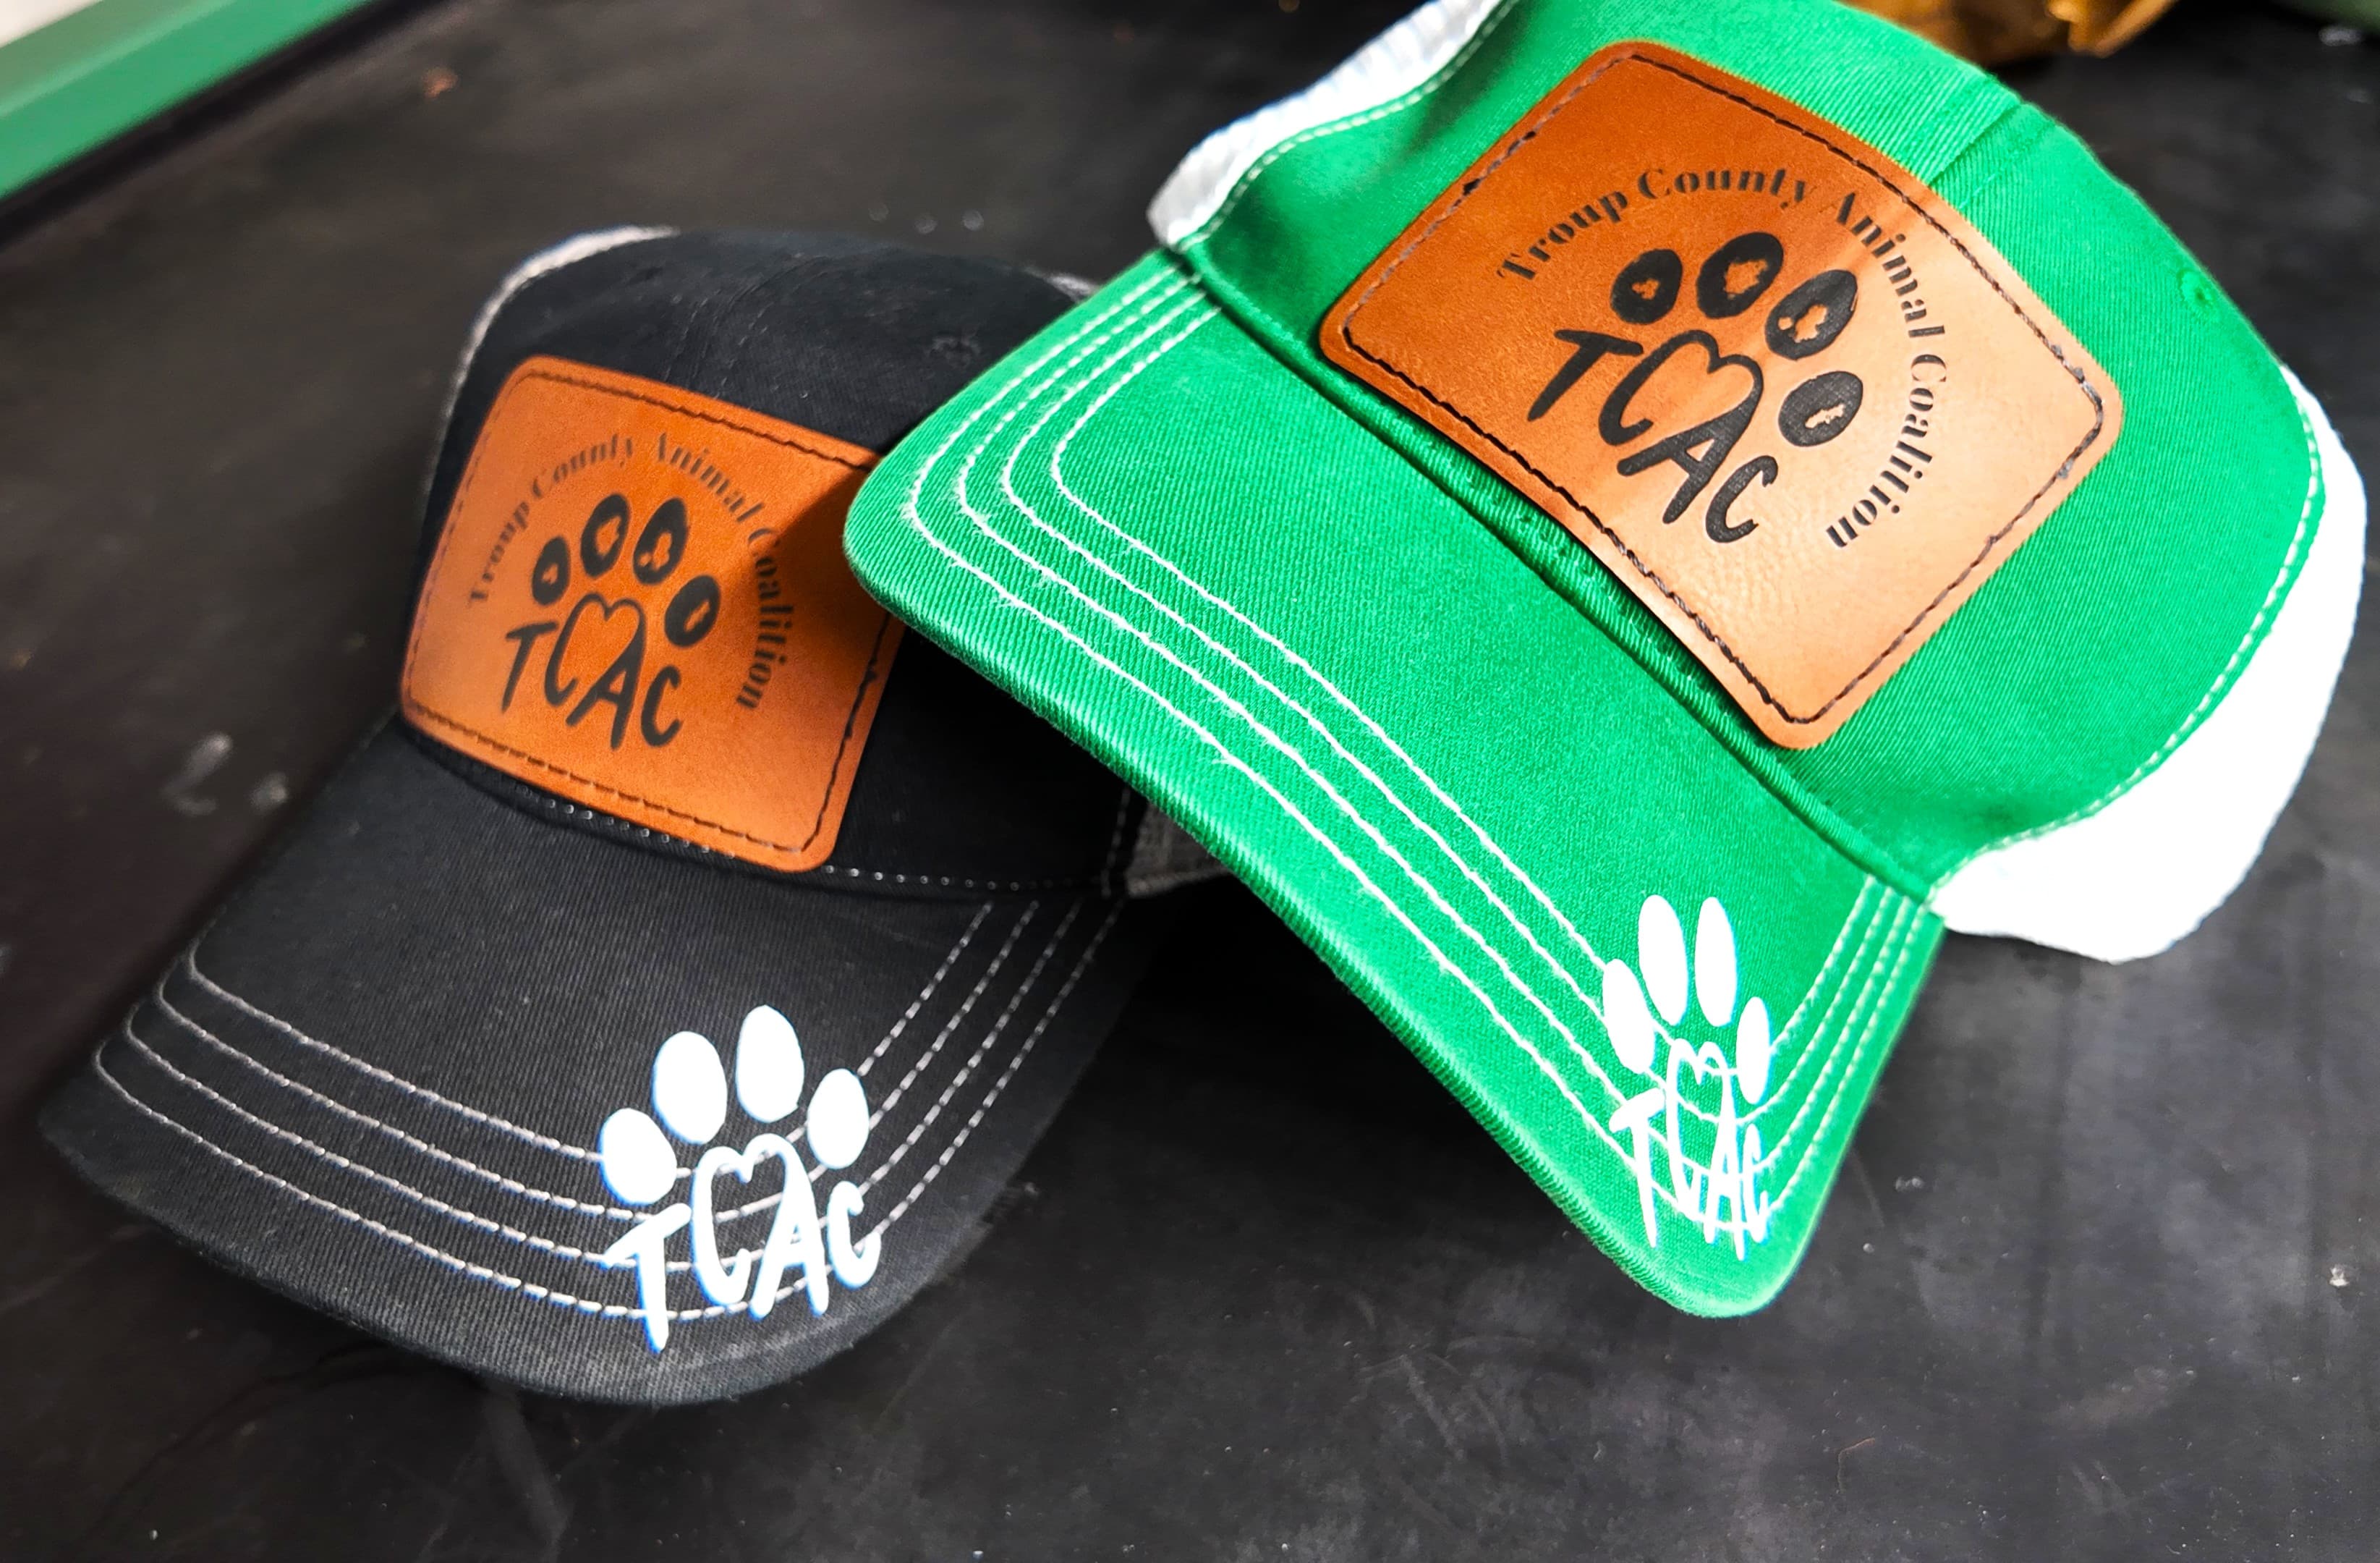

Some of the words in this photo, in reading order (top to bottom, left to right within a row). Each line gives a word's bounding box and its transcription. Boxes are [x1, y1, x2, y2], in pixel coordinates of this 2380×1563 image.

[1496, 187, 1631, 281] Troup
[1636, 166, 1811, 210] County
[1831, 190, 1946, 339] Animal
[1527, 329, 1779, 544] TCAC
[1824, 352, 1947, 549] Coalition
[467, 501, 531, 608] Troup
[532, 433, 634, 499] County
[655, 432, 766, 523] Animal
[735, 527, 794, 710] Coalition
[501, 592, 683, 751] TCAC
[601, 1132, 882, 1353] TCAC
